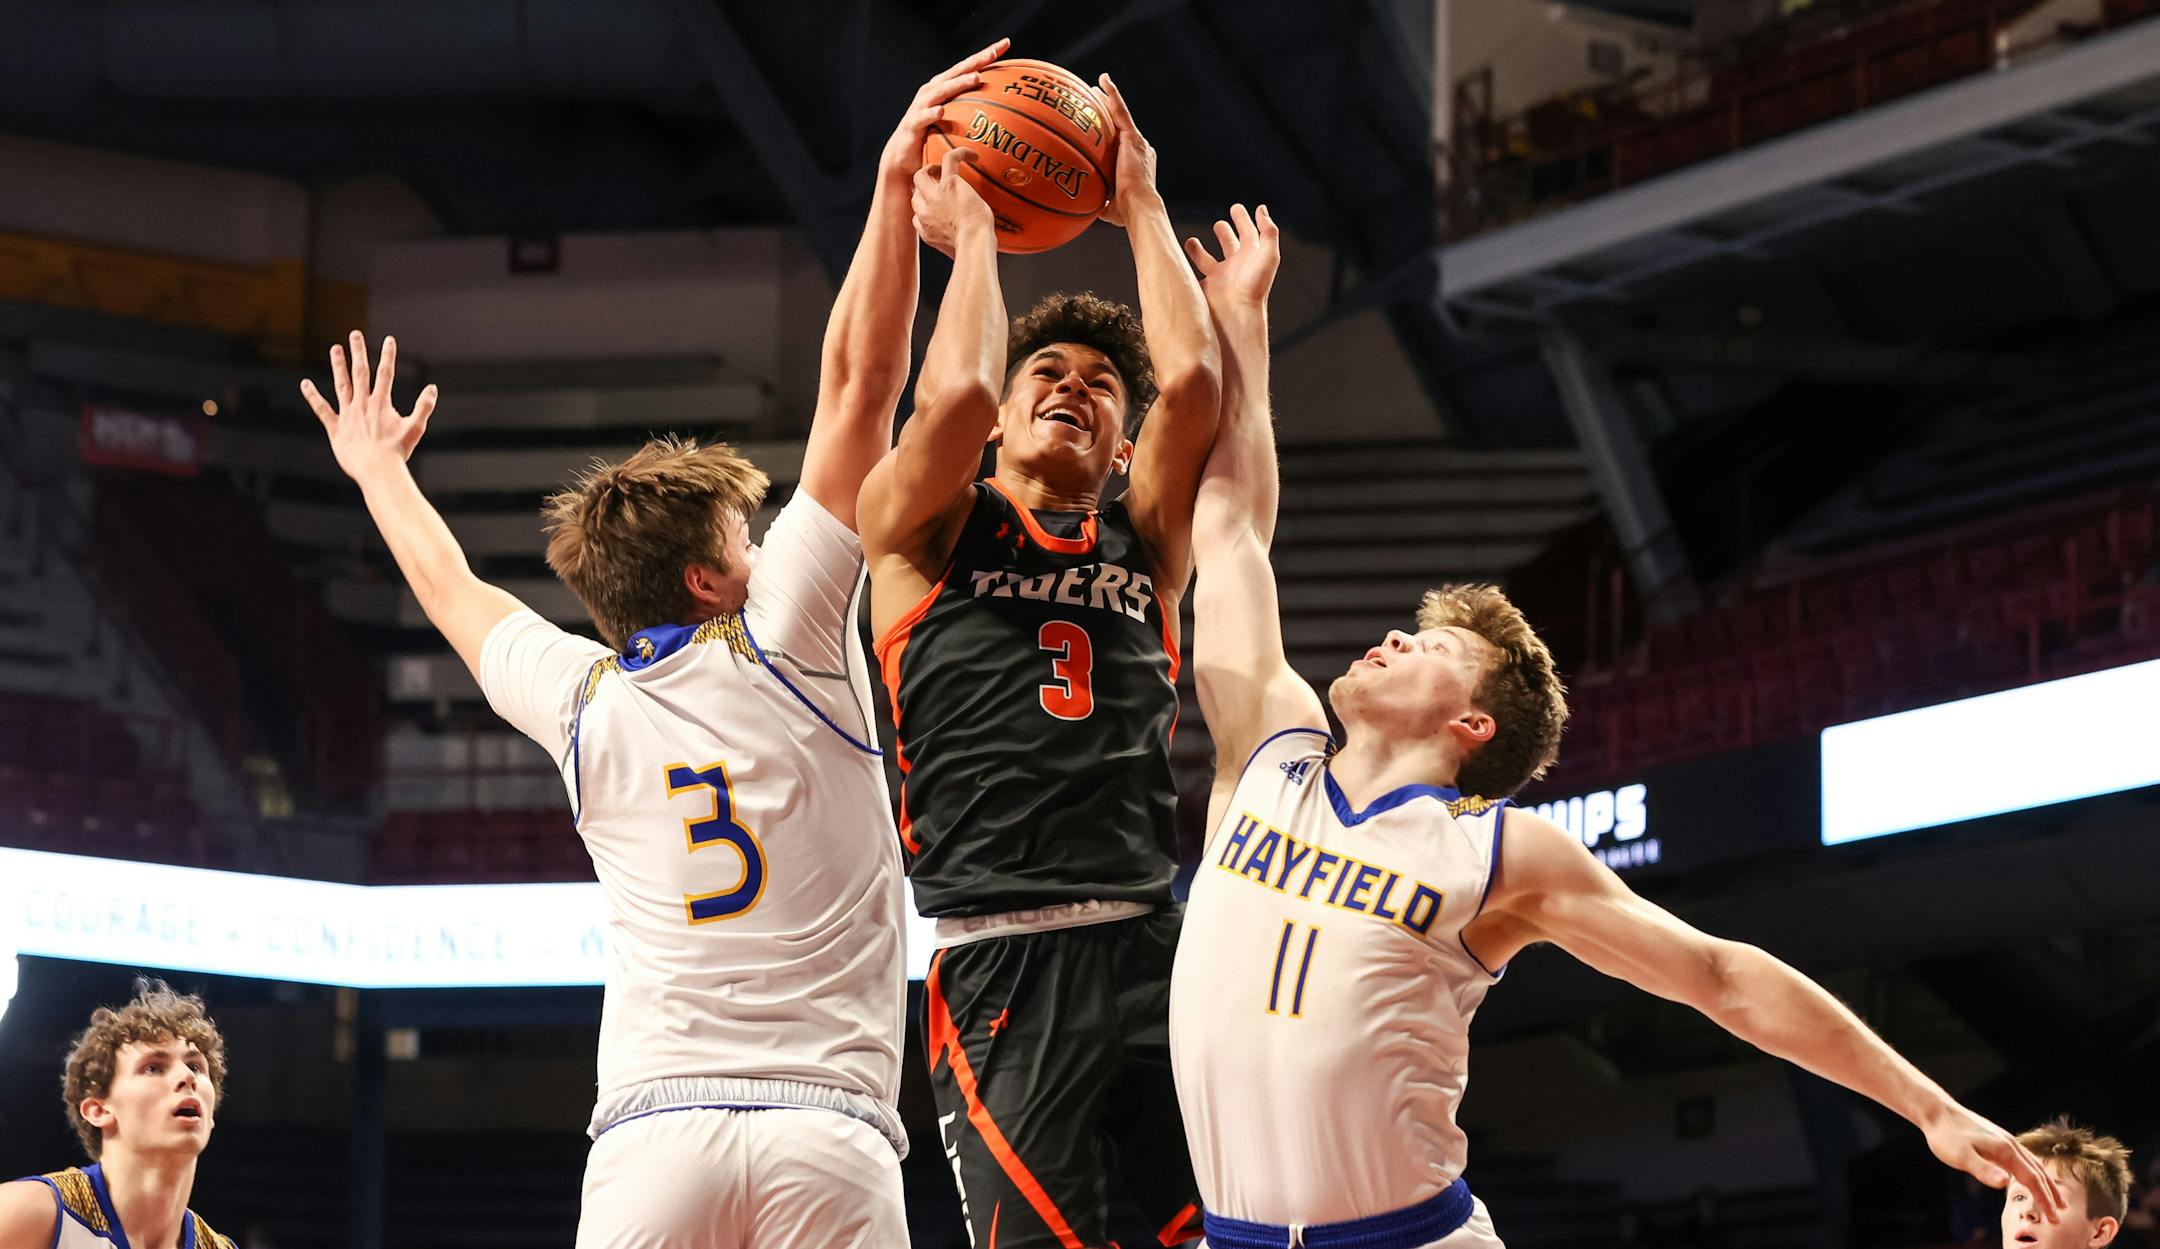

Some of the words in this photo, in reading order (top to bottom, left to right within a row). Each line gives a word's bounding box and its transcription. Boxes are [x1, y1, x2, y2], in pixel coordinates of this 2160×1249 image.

[967, 109, 1088, 199] SPALDING
[1004, 82, 1102, 146] LEGACY
[970, 563, 1152, 623] TIGERS
[1039, 620, 1094, 721] 3
[663, 760, 768, 926] 3
[1216, 810, 1446, 939] HAYFIELD
[25, 889, 202, 945] COURAGE
[265, 913, 508, 961] CONFIDENCE
[1266, 918, 1321, 1018] 11
